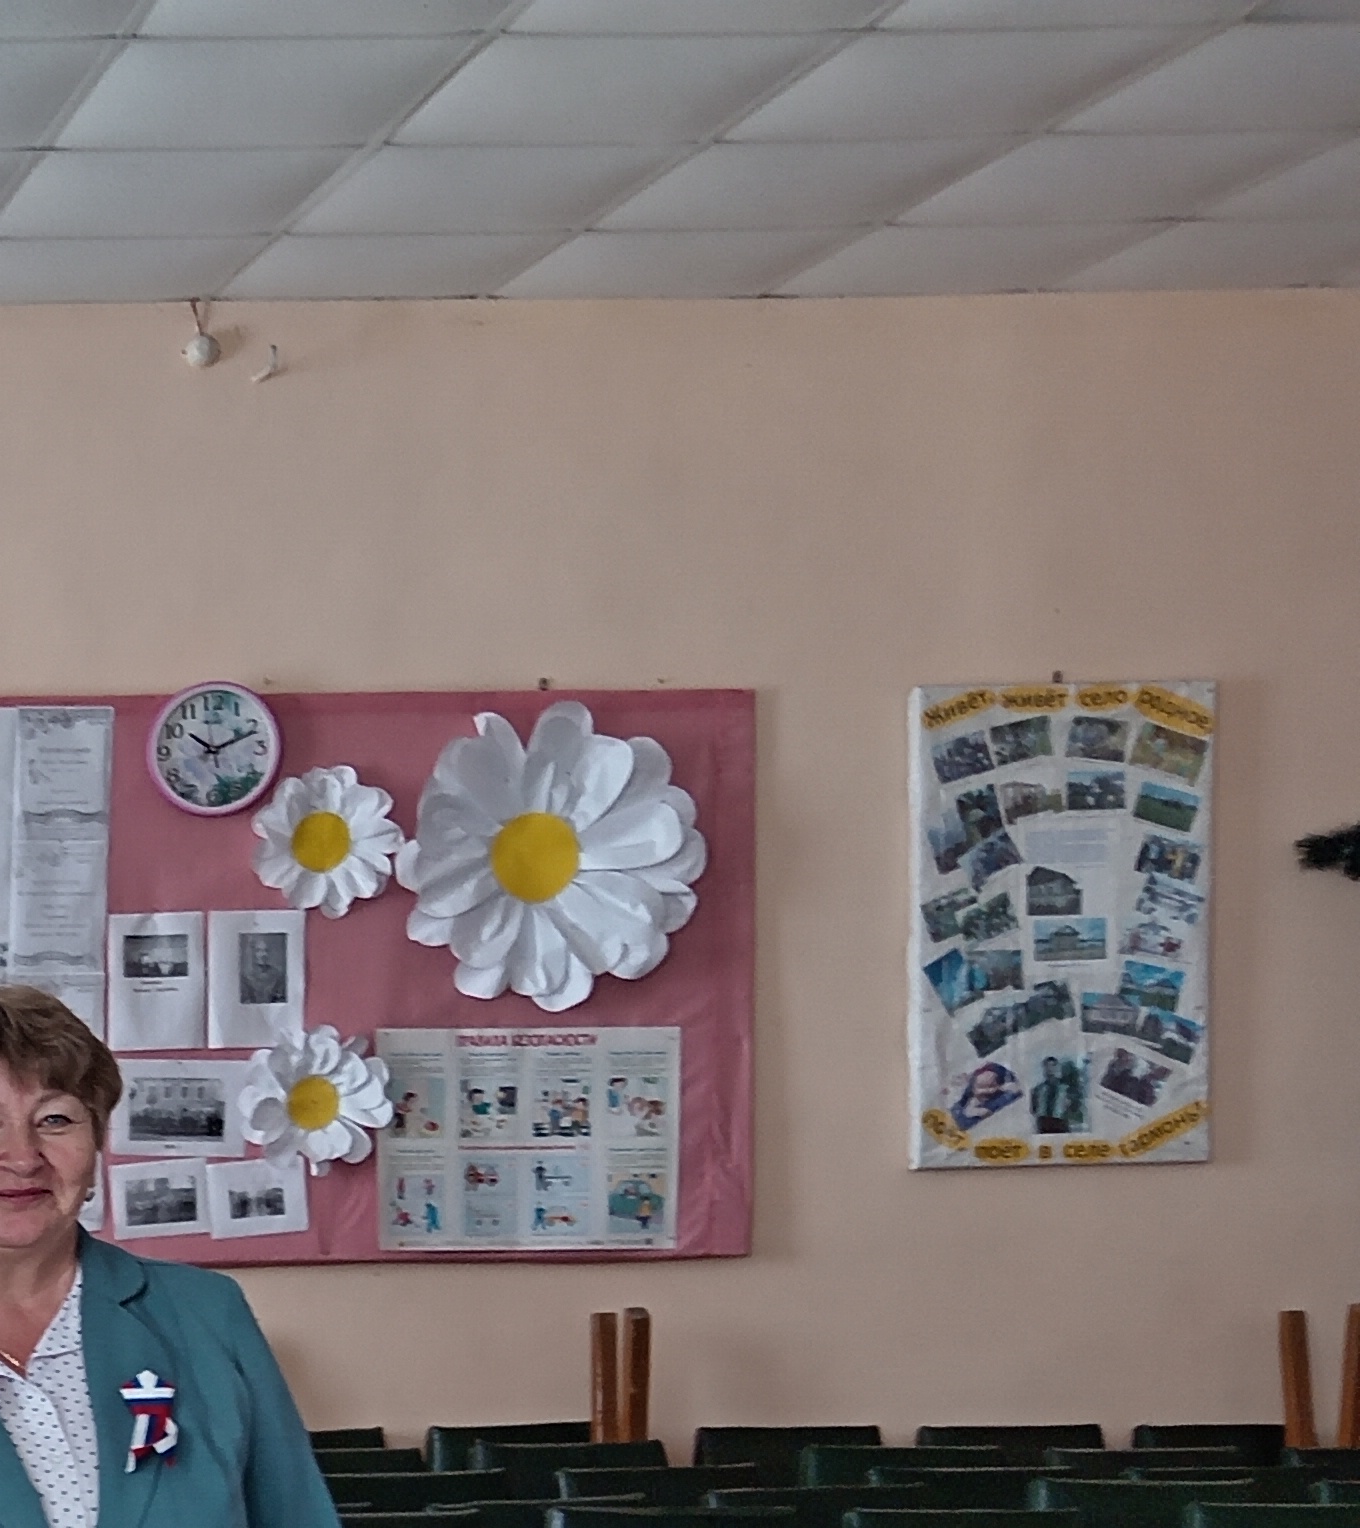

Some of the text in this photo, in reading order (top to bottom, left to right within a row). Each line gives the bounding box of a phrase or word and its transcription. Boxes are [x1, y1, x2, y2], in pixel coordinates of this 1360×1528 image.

[203, 694, 224, 711] 12
[1080, 690, 1128, 707] село
[181, 703, 196, 720] 11
[234, 701, 241, 717] 1
[164, 722, 184, 739] 10
[157, 745, 172, 761] 9
[253, 740, 268, 756] 3
[1064, 1142, 1112, 1158] селе
